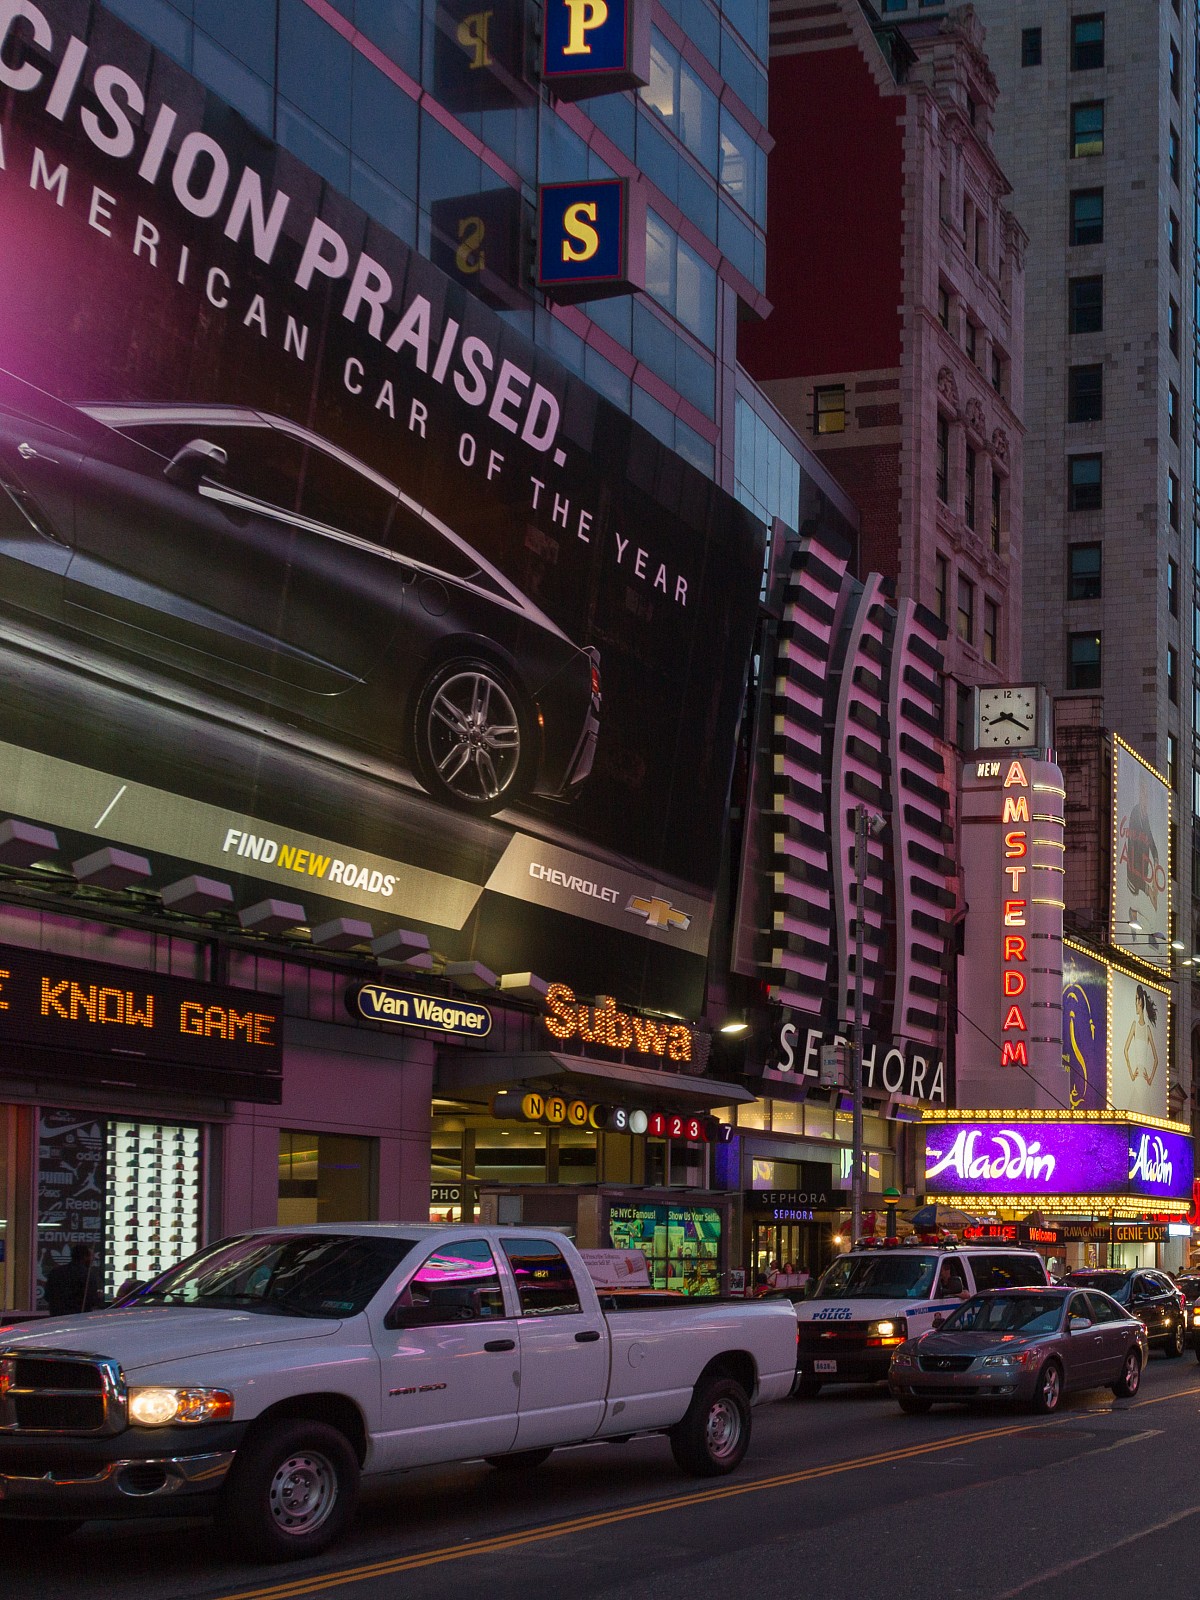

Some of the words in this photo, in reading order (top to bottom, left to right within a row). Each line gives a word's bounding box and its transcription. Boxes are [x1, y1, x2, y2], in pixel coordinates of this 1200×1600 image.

[562, 203, 599, 263] S
[295, 218, 567, 468] PRAISED.
[344, 358, 429, 438] CAR
[459, 434, 505, 481] OF
[531, 476, 592, 543] THE
[615, 531, 690, 606] YEAR
[1003, 691, 1012, 699] 12
[1004, 737, 1010, 745] 6
[222, 828, 278, 865] FIND
[277, 844, 332, 879] NEW
[528, 862, 620, 905] CHEVROLET
[977, 762, 1001, 777] NEW
[1002, 760, 1031, 1068] AMSTERDAM
[41, 977, 155, 1028] KNOW
[180, 1001, 277, 1047] GAME
[371, 987, 412, 1016] Van
[413, 998, 486, 1033] Wagner
[777, 1023, 945, 1103] SEHORA
[530, 1098, 541, 1116] N
[552, 1100, 564, 1120] R
[574, 1104, 586, 1122] Q
[616, 1110, 626, 1128] S
[655, 1116, 662, 1132] 1
[673, 1119, 681, 1135] 2
[690, 1121, 698, 1138] 3
[724, 1126, 732, 1141] 7
[925, 1130, 1056, 1181] Aladdin
[1129, 1133, 1173, 1186] Aladdin
[610, 1208, 618, 1218] Be
[618, 1209, 632, 1218] NYC
[633, 1209, 656, 1219] Famous!
[668, 1211, 683, 1221] Show
[684, 1212, 691, 1221] Us
[692, 1212, 704, 1221] Your
[762, 1193, 826, 1205] SEPHORA
[774, 1208, 813, 1220] SEPHORA
[812, 1312, 853, 1320] POLICE
